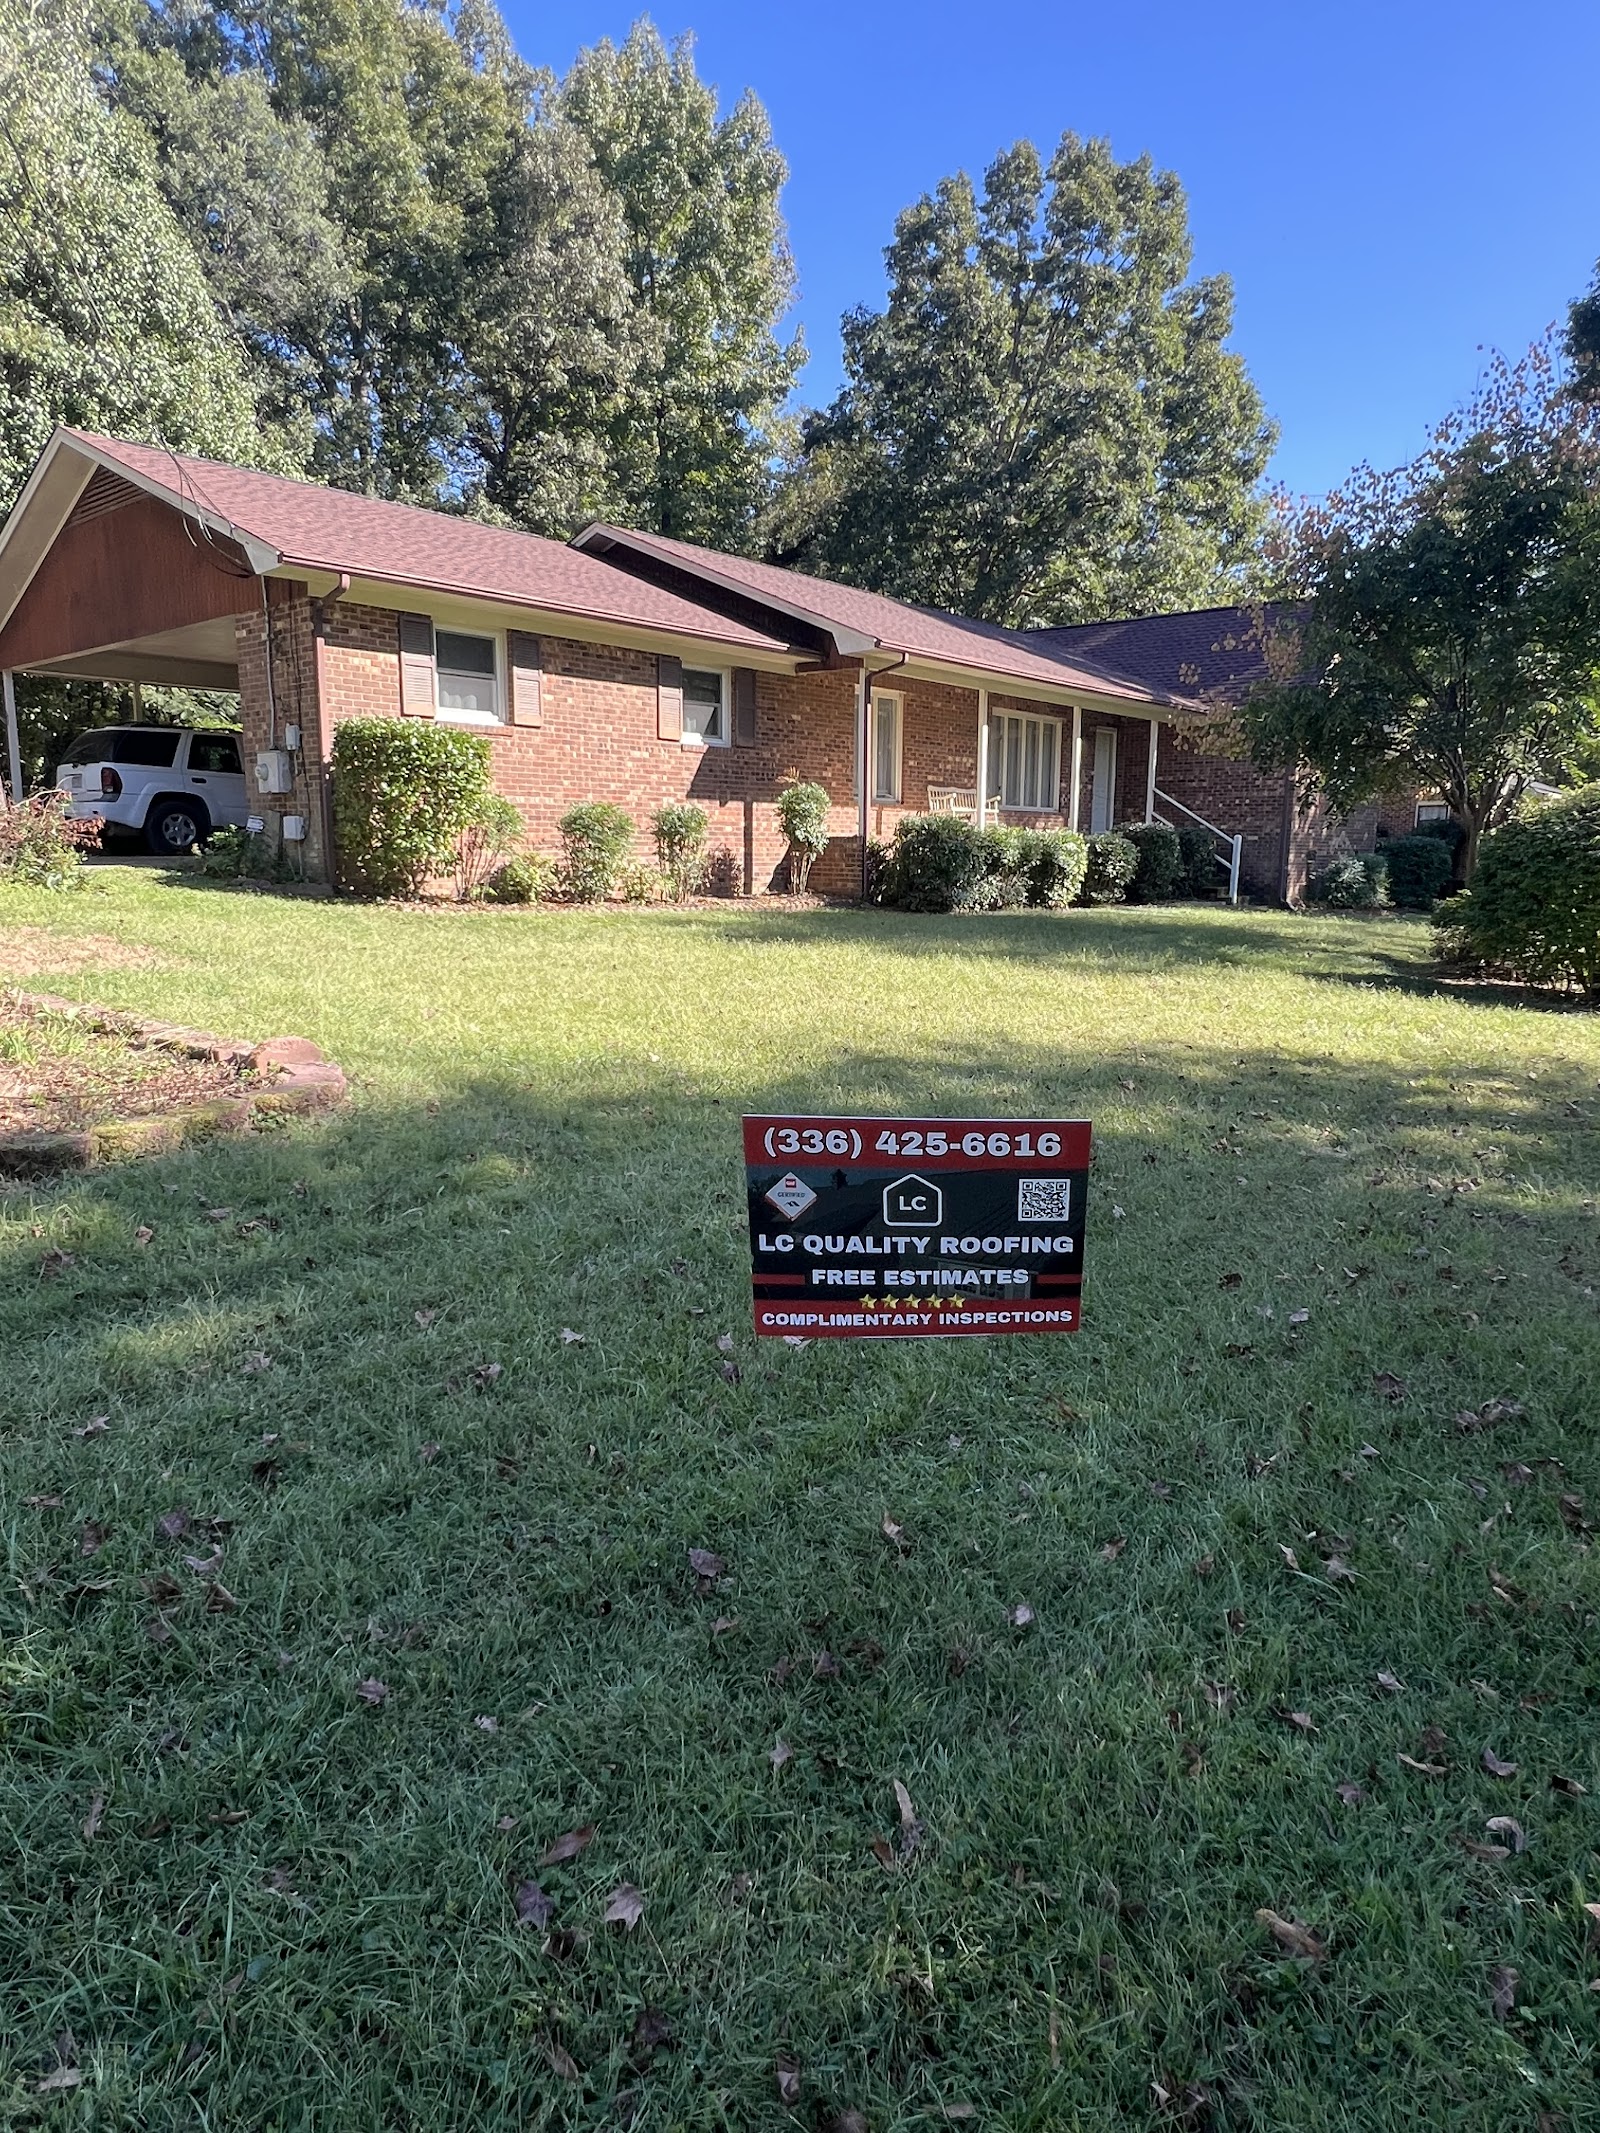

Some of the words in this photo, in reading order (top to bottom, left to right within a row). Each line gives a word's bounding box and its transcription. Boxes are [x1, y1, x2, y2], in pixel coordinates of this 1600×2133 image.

[764, 1127, 862, 1159] (336)
[875, 1130, 1061, 1157] 425-6616
[899, 1195, 927, 1211] LC
[758, 1234, 794, 1252] LC
[803, 1234, 931, 1255] QUALITY
[940, 1236, 1074, 1254] ROOFING
[812, 1269, 876, 1285] FREE
[884, 1268, 1029, 1285] ESTIMATES
[762, 1312, 932, 1326] COMPLIMENTARY
[939, 1310, 1073, 1325] INSPECTIONS
